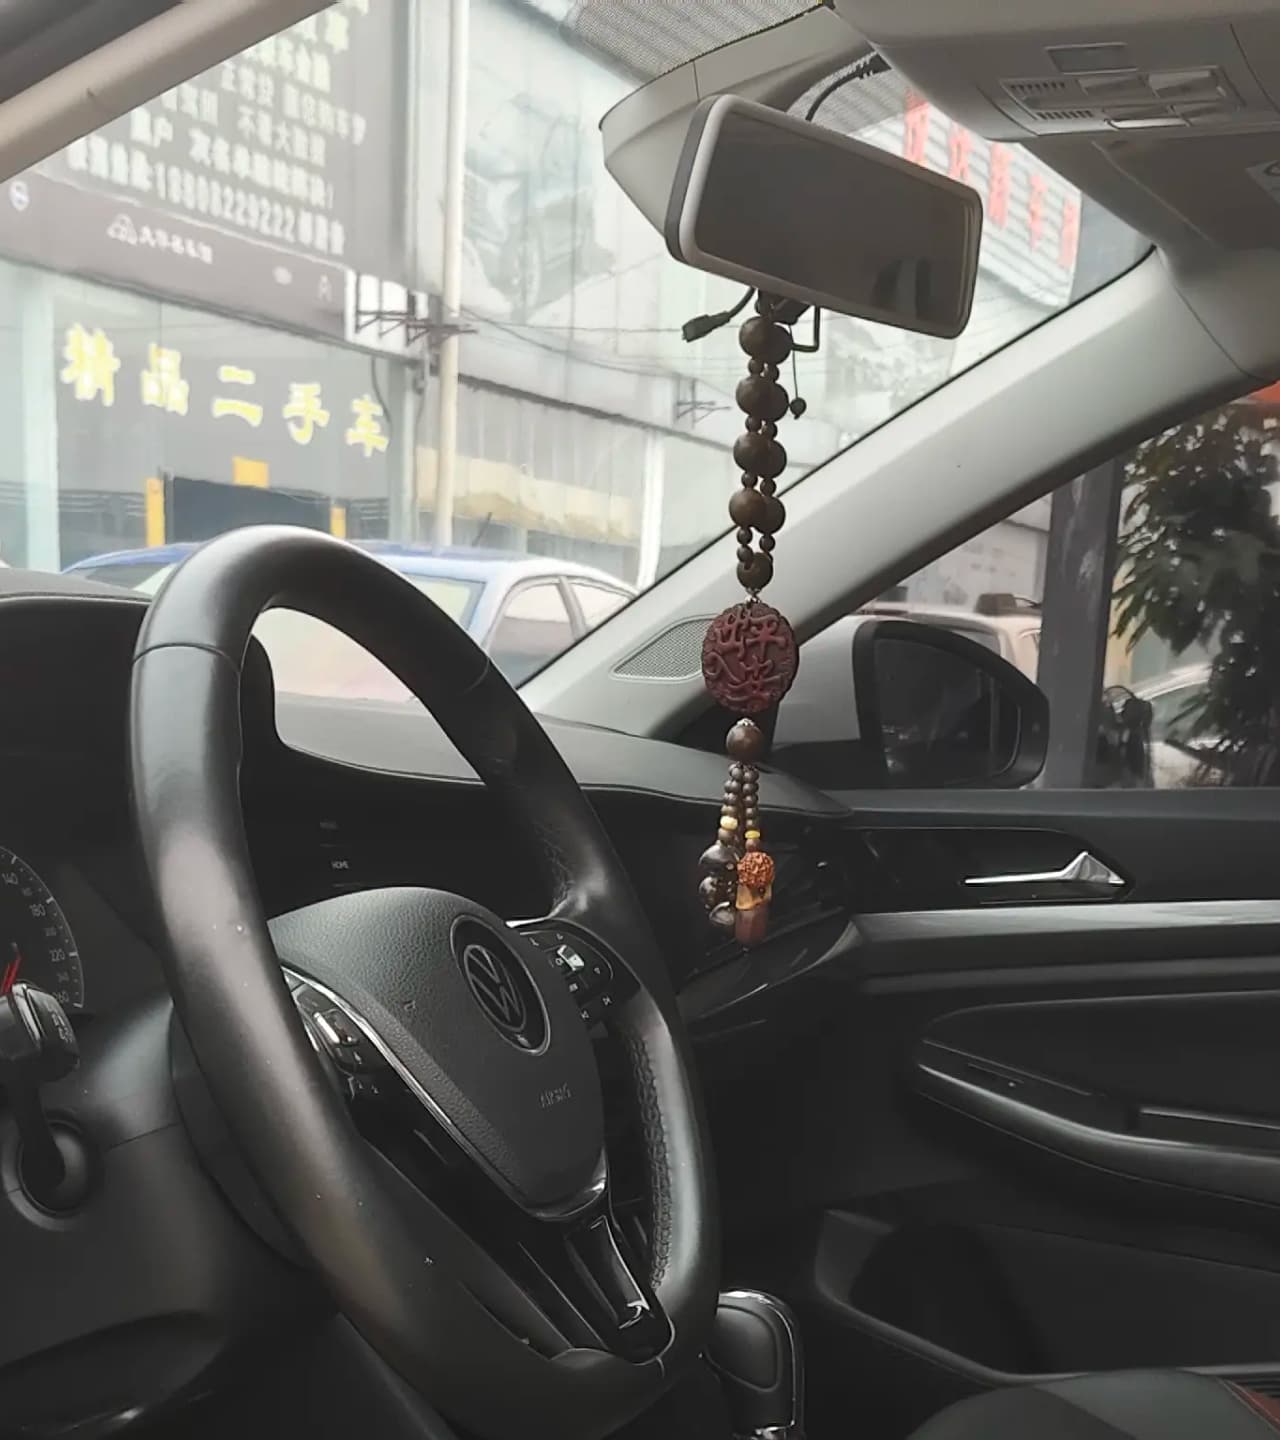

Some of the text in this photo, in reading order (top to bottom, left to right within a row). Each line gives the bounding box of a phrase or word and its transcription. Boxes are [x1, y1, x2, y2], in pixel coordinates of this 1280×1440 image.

[61, 322, 389, 457] 精品二手车
